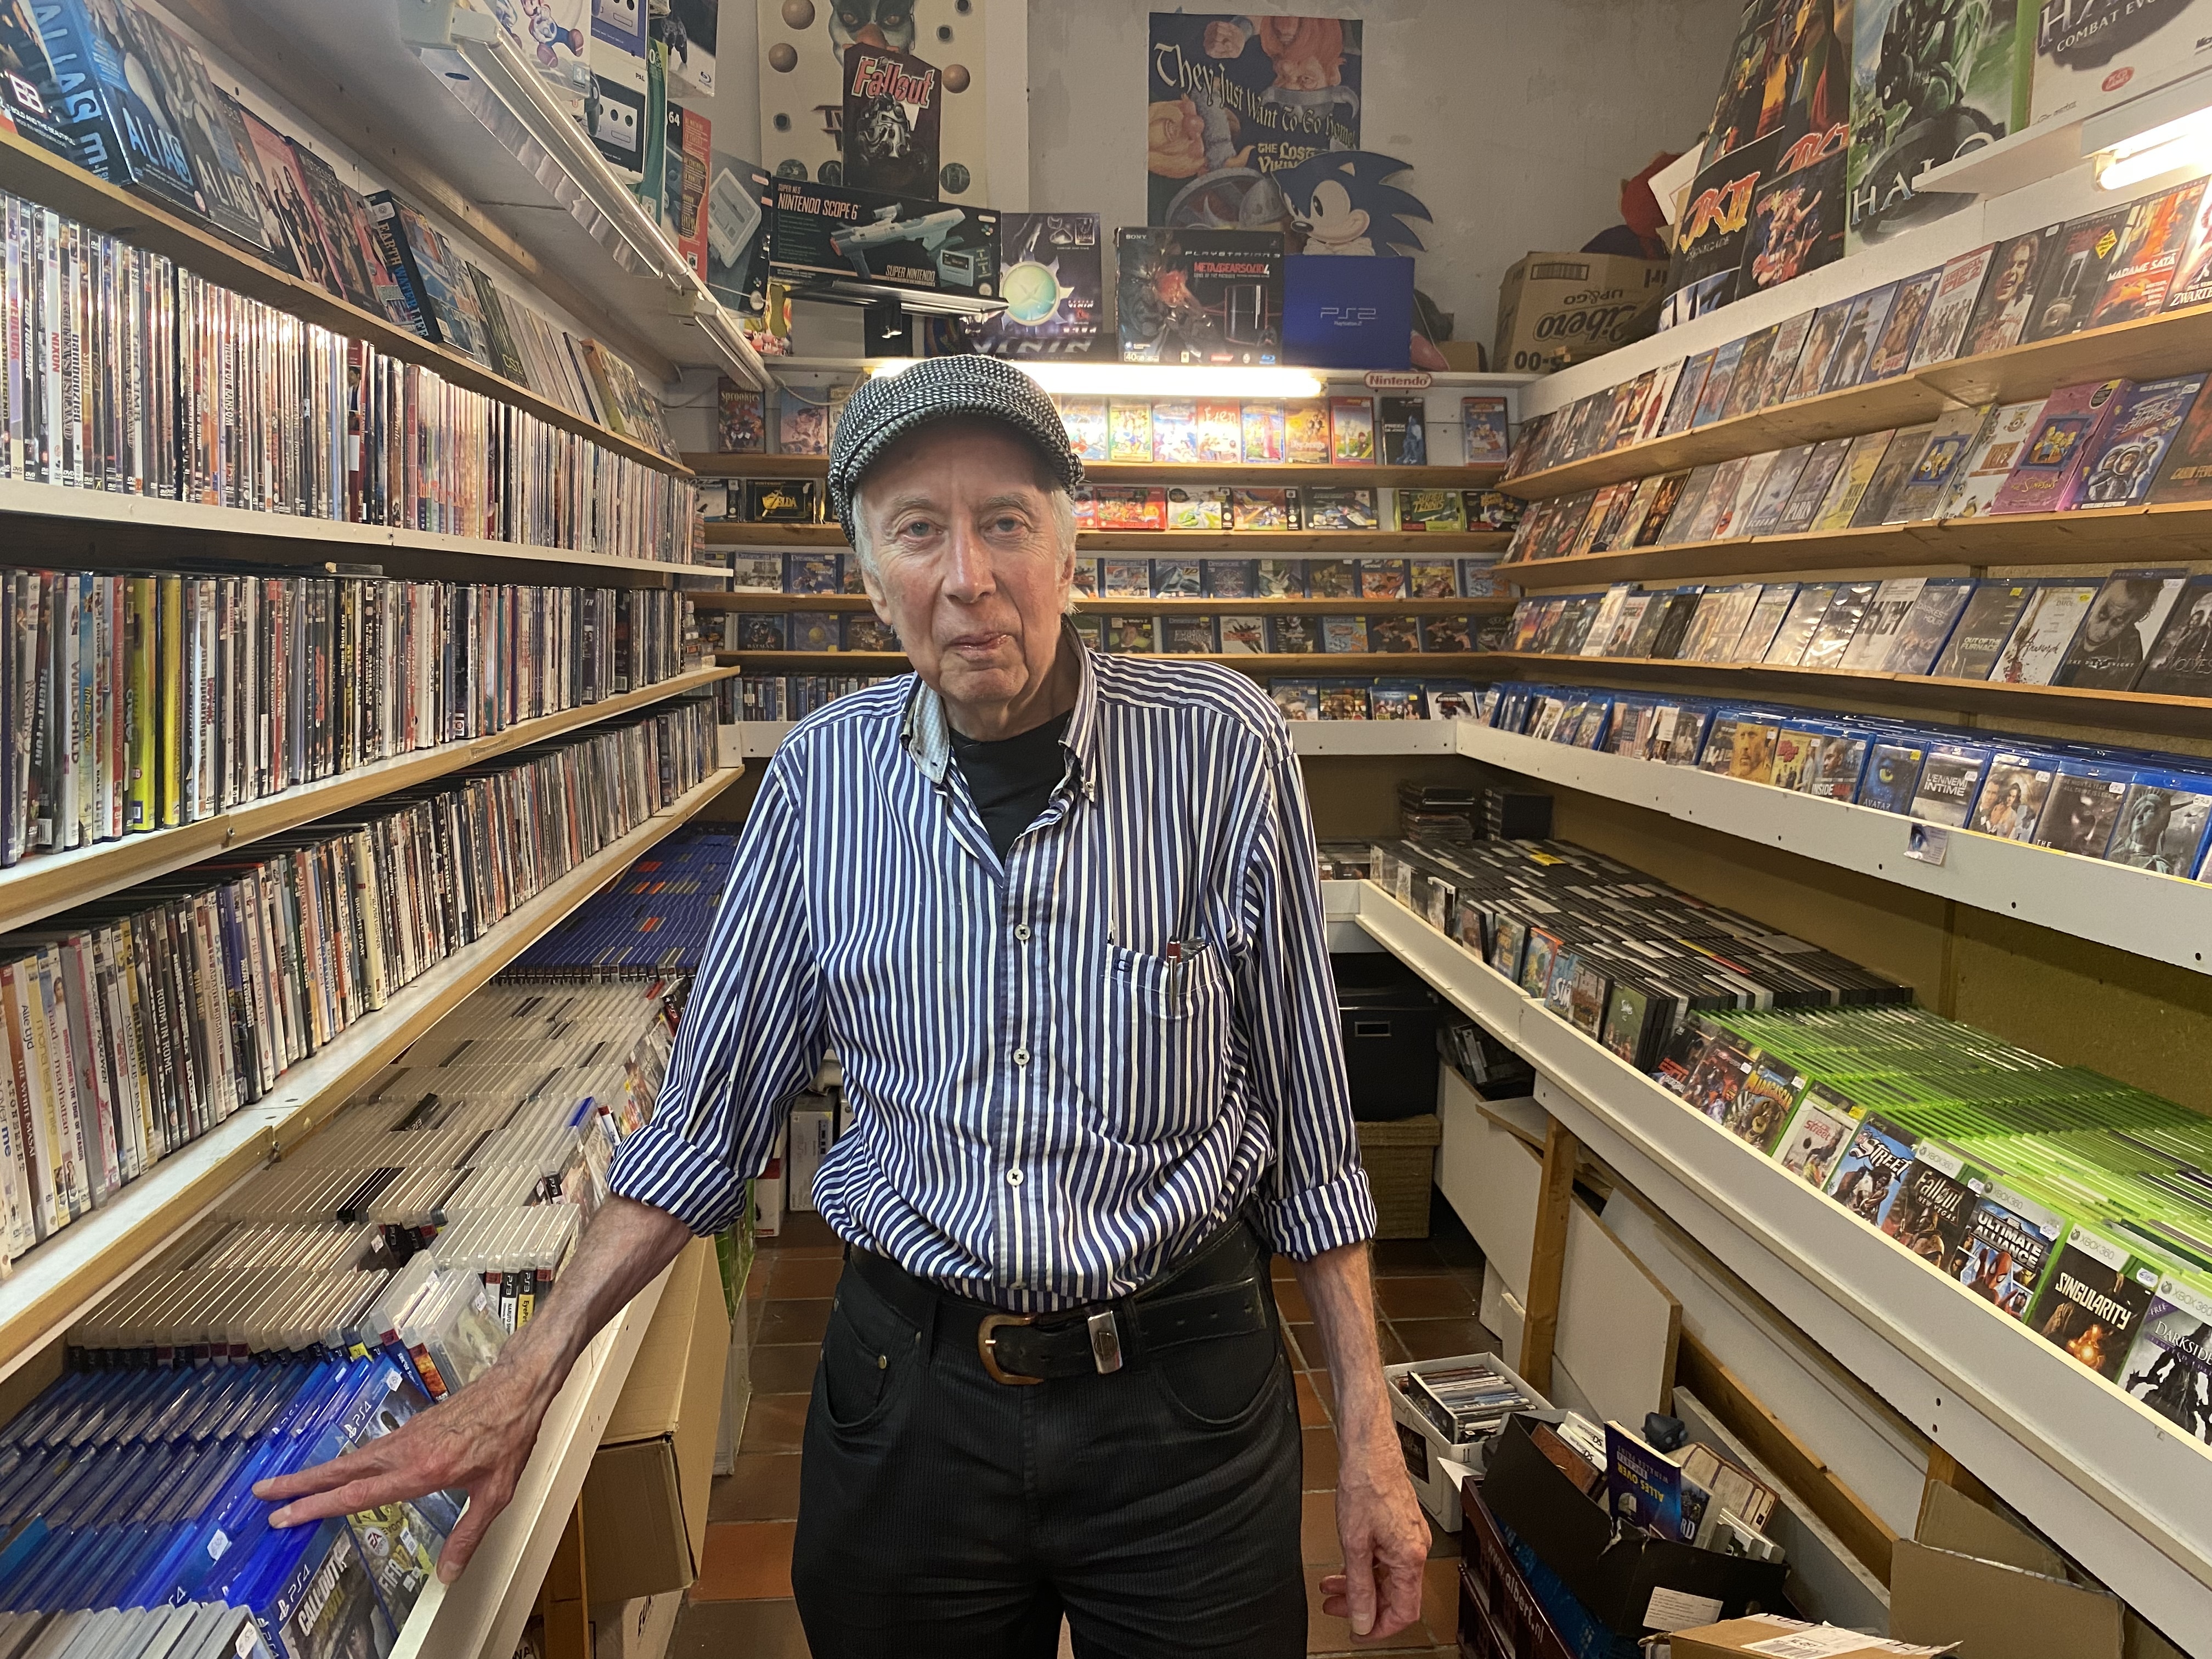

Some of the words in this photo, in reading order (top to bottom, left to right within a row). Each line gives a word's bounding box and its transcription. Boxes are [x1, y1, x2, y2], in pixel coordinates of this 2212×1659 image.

[2057, 9, 2120, 52] COMBAT
[576, 68, 583, 78] 3
[635, 72, 645, 82] PAL
[852, 57, 934, 108] Fallout
[1154, 43, 1214, 105] They
[1218, 63, 1244, 111] Just
[1247, 91, 1278, 129] Want
[1282, 107, 1299, 132] To
[1302, 110, 1322, 134] Go
[668, 111, 680, 126] 64
[122, 108, 193, 186] ALIAS
[1258, 143, 1278, 154] THE
[195, 155, 258, 224] ALIAS
[777, 194, 820, 215] NINTENDO
[823, 198, 850, 218] SCOPE
[850, 205, 857, 220] 6
[379, 222, 402, 266] EARTH
[395, 264, 417, 308] WATER
[411, 308, 430, 338] LIFE
[886, 265, 906, 277] SUPER
[907, 268, 935, 282] NINTENDO
[2107, 262, 2149, 281] MADAME
[1564, 290, 1623, 304] UP&GO
[24, 300, 32, 325] ZERO
[1321, 307, 1377, 319] PS2
[1536, 305, 1637, 342] Libero
[10, 298, 20, 360] WEDLOCK
[25, 328, 33, 379] TOLERANCE
[52, 332, 61, 373] NIXON
[224, 343, 233, 366] HELD
[224, 368, 233, 386] FOR
[1370, 376, 1427, 387] Nintendo
[224, 388, 234, 426] RANSOM
[721, 391, 760, 402] Sprookjes
[2163, 416, 2181, 431] 3D
[1414, 501, 1444, 513] TENNIS
[1961, 644, 1999, 652] FURNACE
[115, 643, 124, 686] friends
[37, 669, 48, 714] FLIGHT
[115, 690, 124, 710] with
[114, 714, 123, 752] money
[34, 731, 44, 767] FURY
[1812, 783, 1833, 795] INSIDE
[1924, 781, 1966, 797] INTIME
[1926, 774, 1967, 787] L'ENNEMI
[2036, 839, 2052, 848] THE
[340, 906, 348, 930] LUCK
[354, 897, 363, 930] BRIGHT
[342, 933, 351, 973] CHUCK
[357, 933, 365, 956] STAR
[240, 959, 249, 981] MIJN
[210, 967, 220, 1003] AMANTS
[22, 1005, 32, 1028] Alle
[156, 989, 168, 1024] ROOM
[242, 983, 254, 1028] KINDEREN
[22, 1029, 35, 1050] tijd
[35, 1019, 49, 1064] mona
[159, 1026, 170, 1039] IN
[213, 1005, 225, 1054] CRIMINELS
[126, 1015, 139, 1088] MONSTER'S
[161, 1042, 173, 1075] ROME
[17, 1058, 26, 1081] THE
[41, 1068, 54, 1093] lisa
[47, 1005, 60, 1041] maid
[54, 1060, 71, 1136] manhattan
[19, 1084, 31, 1119] WHITE
[68, 1086, 76, 1100] THE
[1745, 1071, 1793, 1111] MADAGASCAR
[7, 1080, 26, 1171] ATONEMENT
[45, 1097, 59, 1136] smile
[72, 1122, 80, 1131] OF
[1, 1127, 13, 1157] me
[25, 1124, 36, 1158] MASAI
[74, 1132, 83, 1161] REASON
[1849, 1138, 1912, 1182] STREET
[549, 1178, 558, 1195] PS3
[1915, 1171, 1967, 1212] Fallout
[1993, 1187, 2010, 1203] XBOX
[2008, 1197, 2023, 1209] 360
[1918, 1195, 1931, 1207] NEW
[1934, 1204, 1957, 1223] VEGAS
[1973, 1224, 2038, 1269] ALLIANCE
[1977, 1210, 2046, 1257] ULTIMATE
[2079, 1233, 2099, 1253] XBOX
[2097, 1246, 2114, 1261] 360
[2055, 1272, 2132, 1330] SINGULARITY
[2151, 1303, 2169, 1316] FREE
[2172, 1286, 2195, 1309] XBOX
[2193, 1300, 2212, 1317] 360
[353, 1401, 373, 1426] PS4
[1618, 1464, 1638, 1484] OVER
[1640, 1479, 1663, 1502] ALLES
[368, 1531, 382, 1549] EA
[289, 1564, 311, 1602] PS4
[379, 1559, 404, 1595] FIFA
[1487, 1544, 1546, 1644] www.albert.nl
